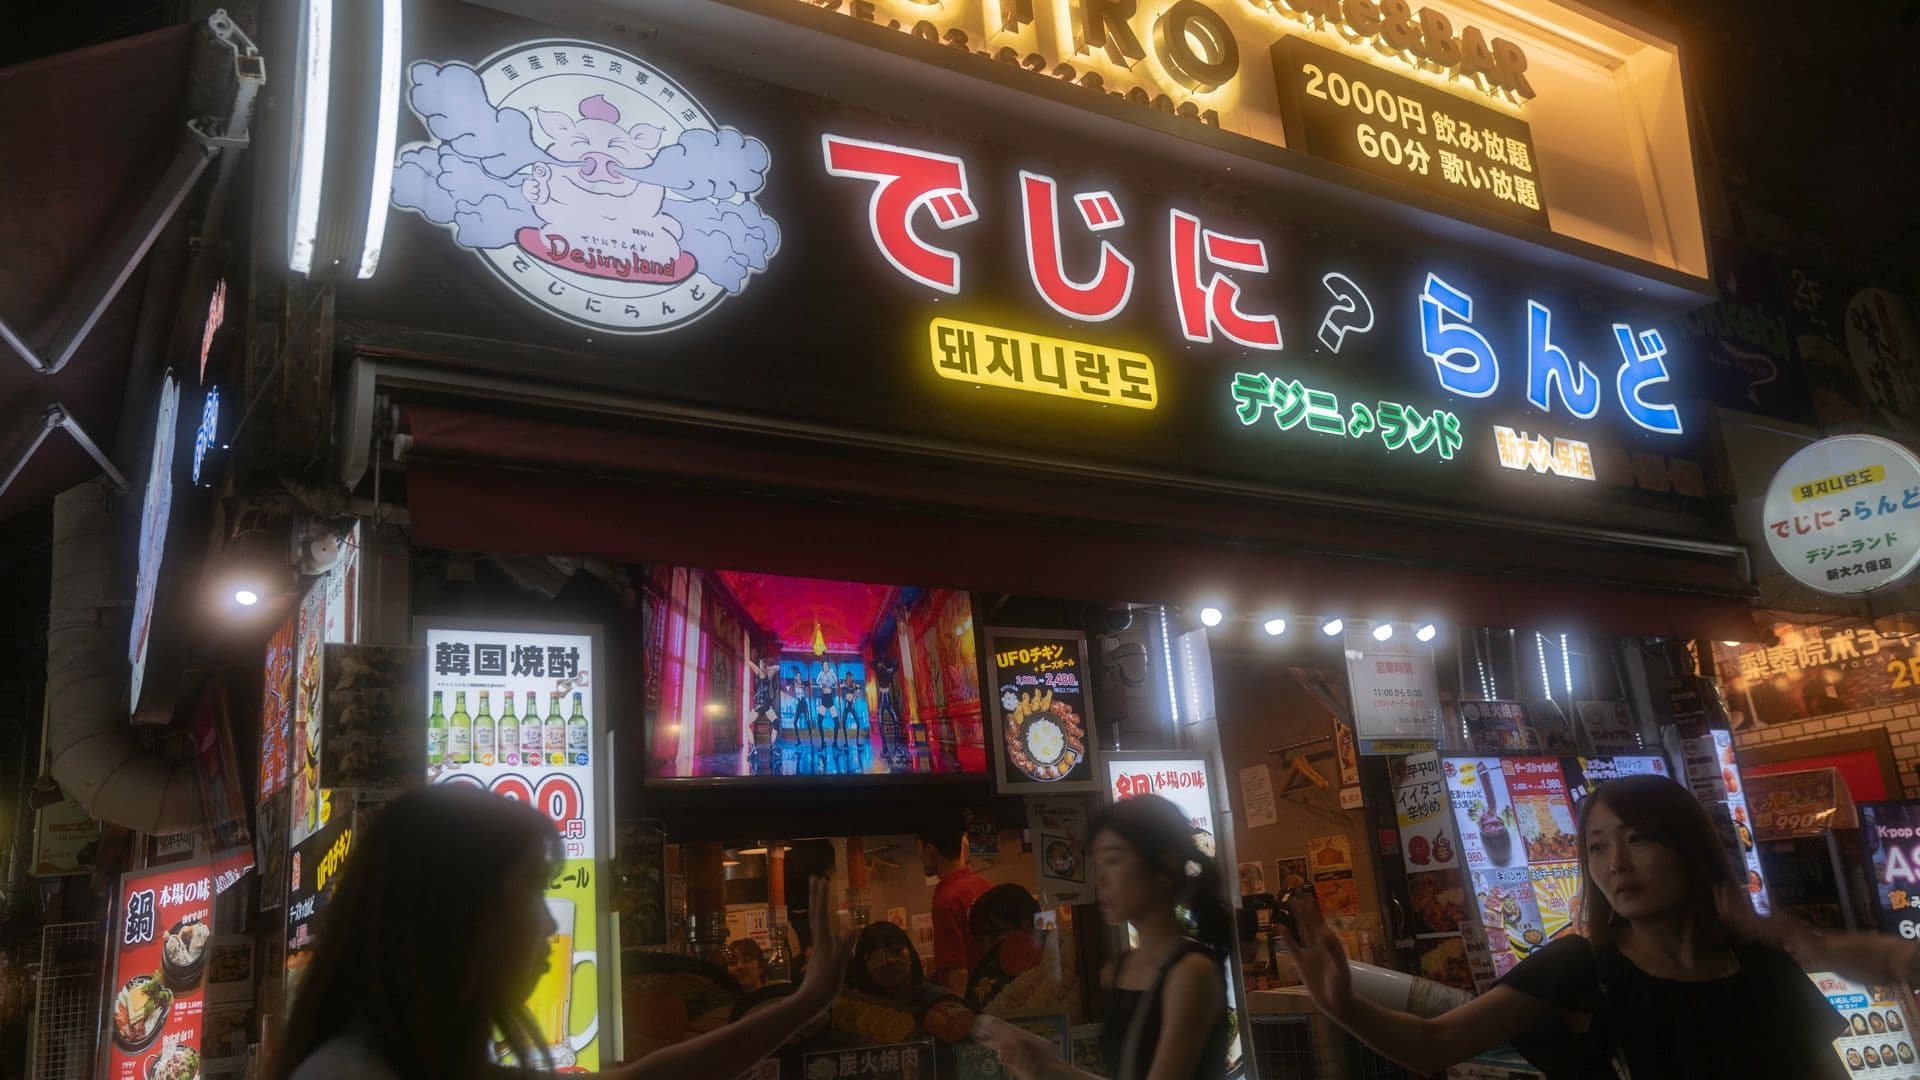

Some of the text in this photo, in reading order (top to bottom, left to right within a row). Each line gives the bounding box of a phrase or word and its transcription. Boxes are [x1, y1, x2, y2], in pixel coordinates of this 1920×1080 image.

[1301, 62, 1533, 173] 2000円 飲み放題
[1356, 123, 1541, 211] 60分 歌い放題
[546, 233, 677, 279] Dejinyland
[936, 323, 1155, 404] 돼지니란도
[1493, 425, 1597, 482] 新大久保店
[1800, 470, 1874, 500] 돼지니란도
[1805, 531, 1899, 564] デジニランド
[1826, 557, 1893, 581] 新大久保店
[434, 641, 581, 679] 韓国焼酎
[996, 644, 1064, 669] UFOチキン
[1840, 654, 1896, 671] POCHA
[1153, 771, 1205, 790] 本場の味
[1398, 781, 1442, 807] イイダコ
[1407, 797, 1441, 821] 辛炒め
[1877, 825, 1913, 839] K-pop
[158, 877, 211, 908] 本場の味
[124, 888, 156, 945] 鍋
[839, 1046, 919, 1076] 炭火焼肉
